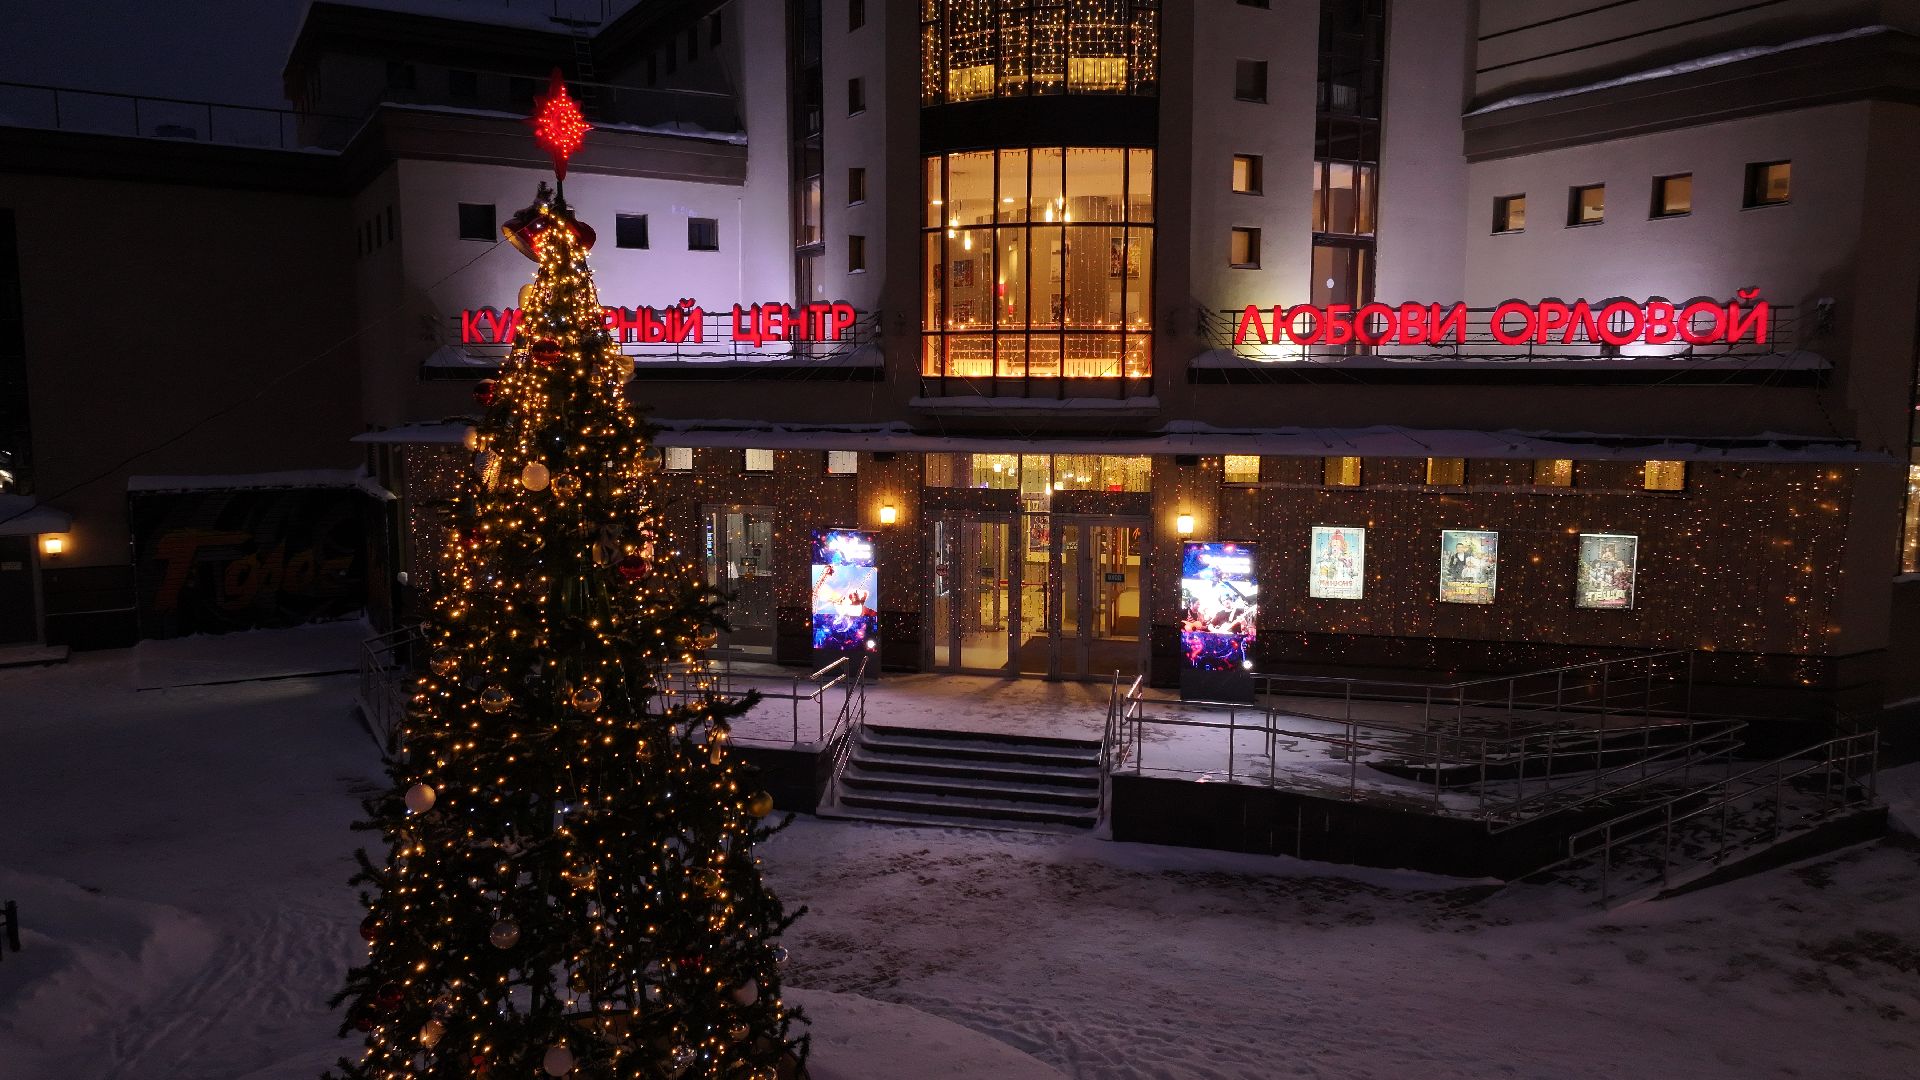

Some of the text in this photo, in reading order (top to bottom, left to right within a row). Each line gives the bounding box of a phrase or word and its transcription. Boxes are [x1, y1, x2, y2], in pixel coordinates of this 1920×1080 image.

[460, 298, 857, 348] КУЛРНЫЙ ЦЕНТР
[1234, 288, 1769, 346] ЛЮБОВИ ОРЛОВОЙ
